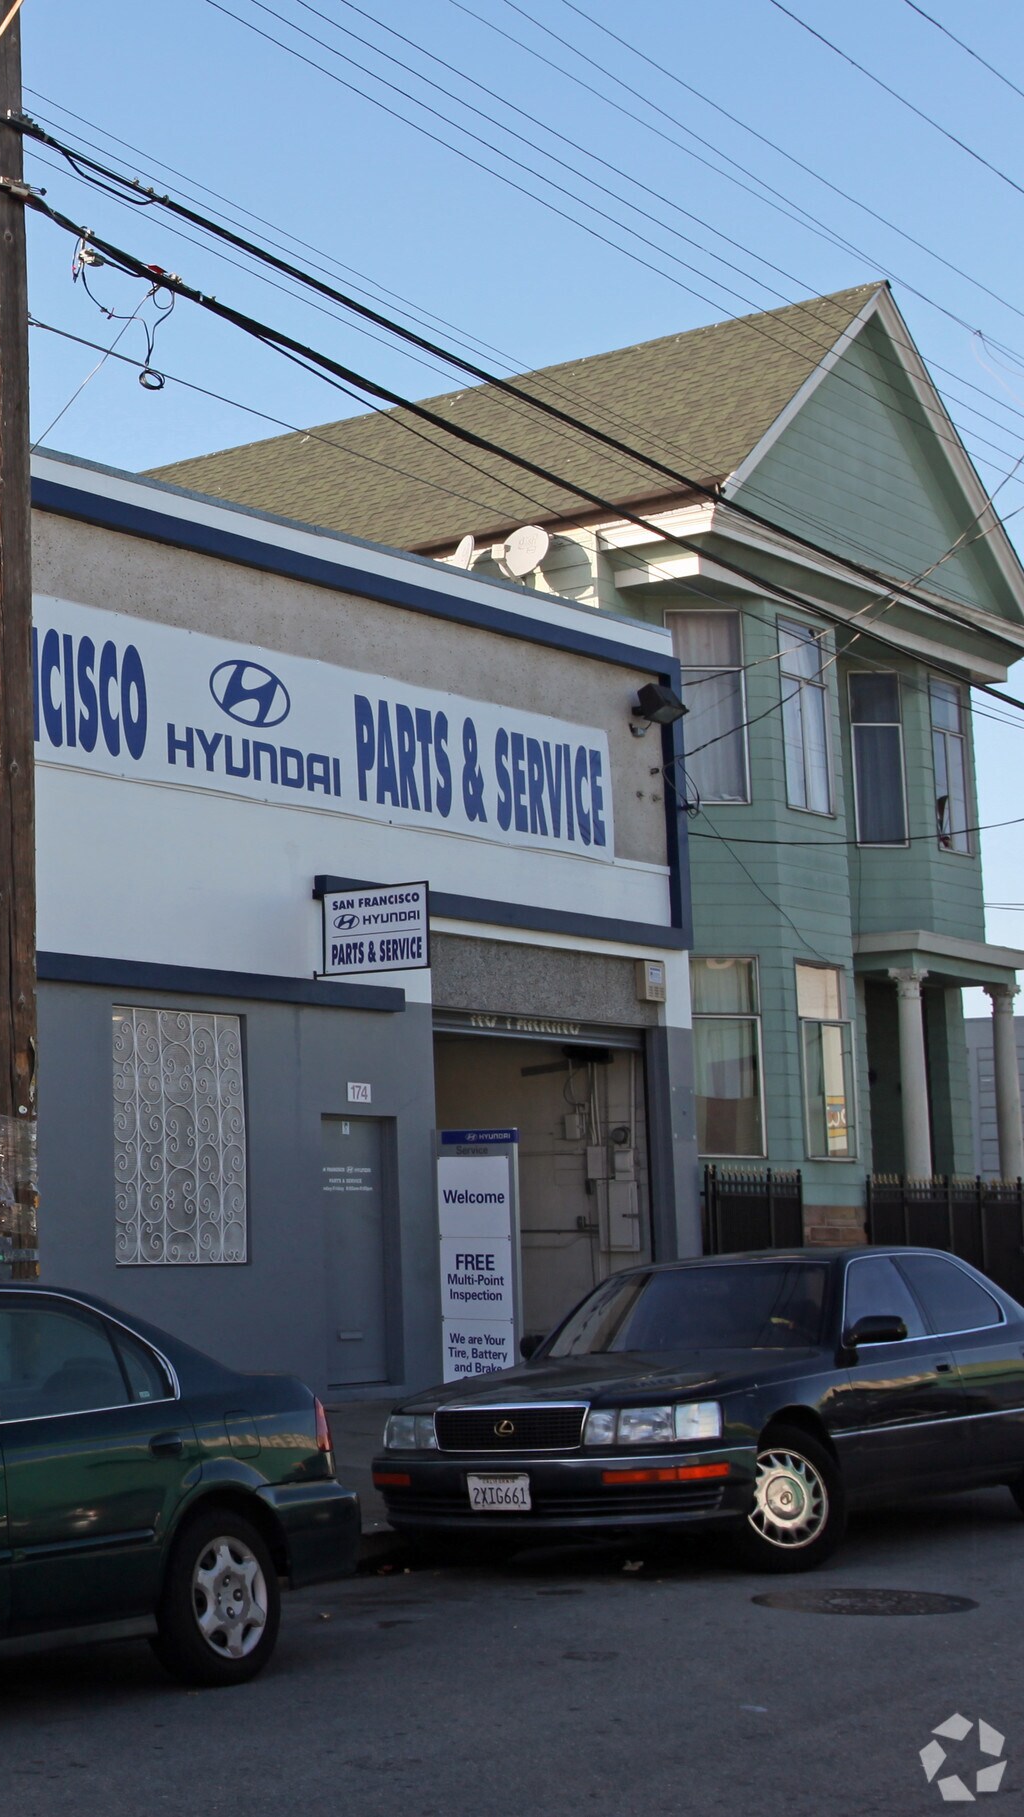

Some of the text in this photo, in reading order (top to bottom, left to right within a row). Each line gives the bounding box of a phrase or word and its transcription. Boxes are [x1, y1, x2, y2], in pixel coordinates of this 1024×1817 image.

[167, 723, 341, 797] HYUNDAI
[354, 694, 452, 818] PARTS
[463, 717, 488, 823] &
[495, 727, 606, 847] SERVICE
[332, 892, 419, 911] SAN FRANCISCO
[362, 910, 420, 925] HYUNDAI
[331, 936, 422, 966] PARTS & SERVICE
[350, 1084, 368, 1100] 174
[456, 1145, 488, 1155] Service
[443, 1189, 504, 1204] Welcome
[456, 1254, 495, 1271] FREE
[447, 1273, 504, 1286] Multi-Point
[450, 1289, 502, 1302] Inspection
[450, 1333, 505, 1346] We are Your
[448, 1347, 508, 1363] Tire, Battery
[454, 1363, 472, 1373] and
[473, 1487, 527, 1505] 2XIG661
